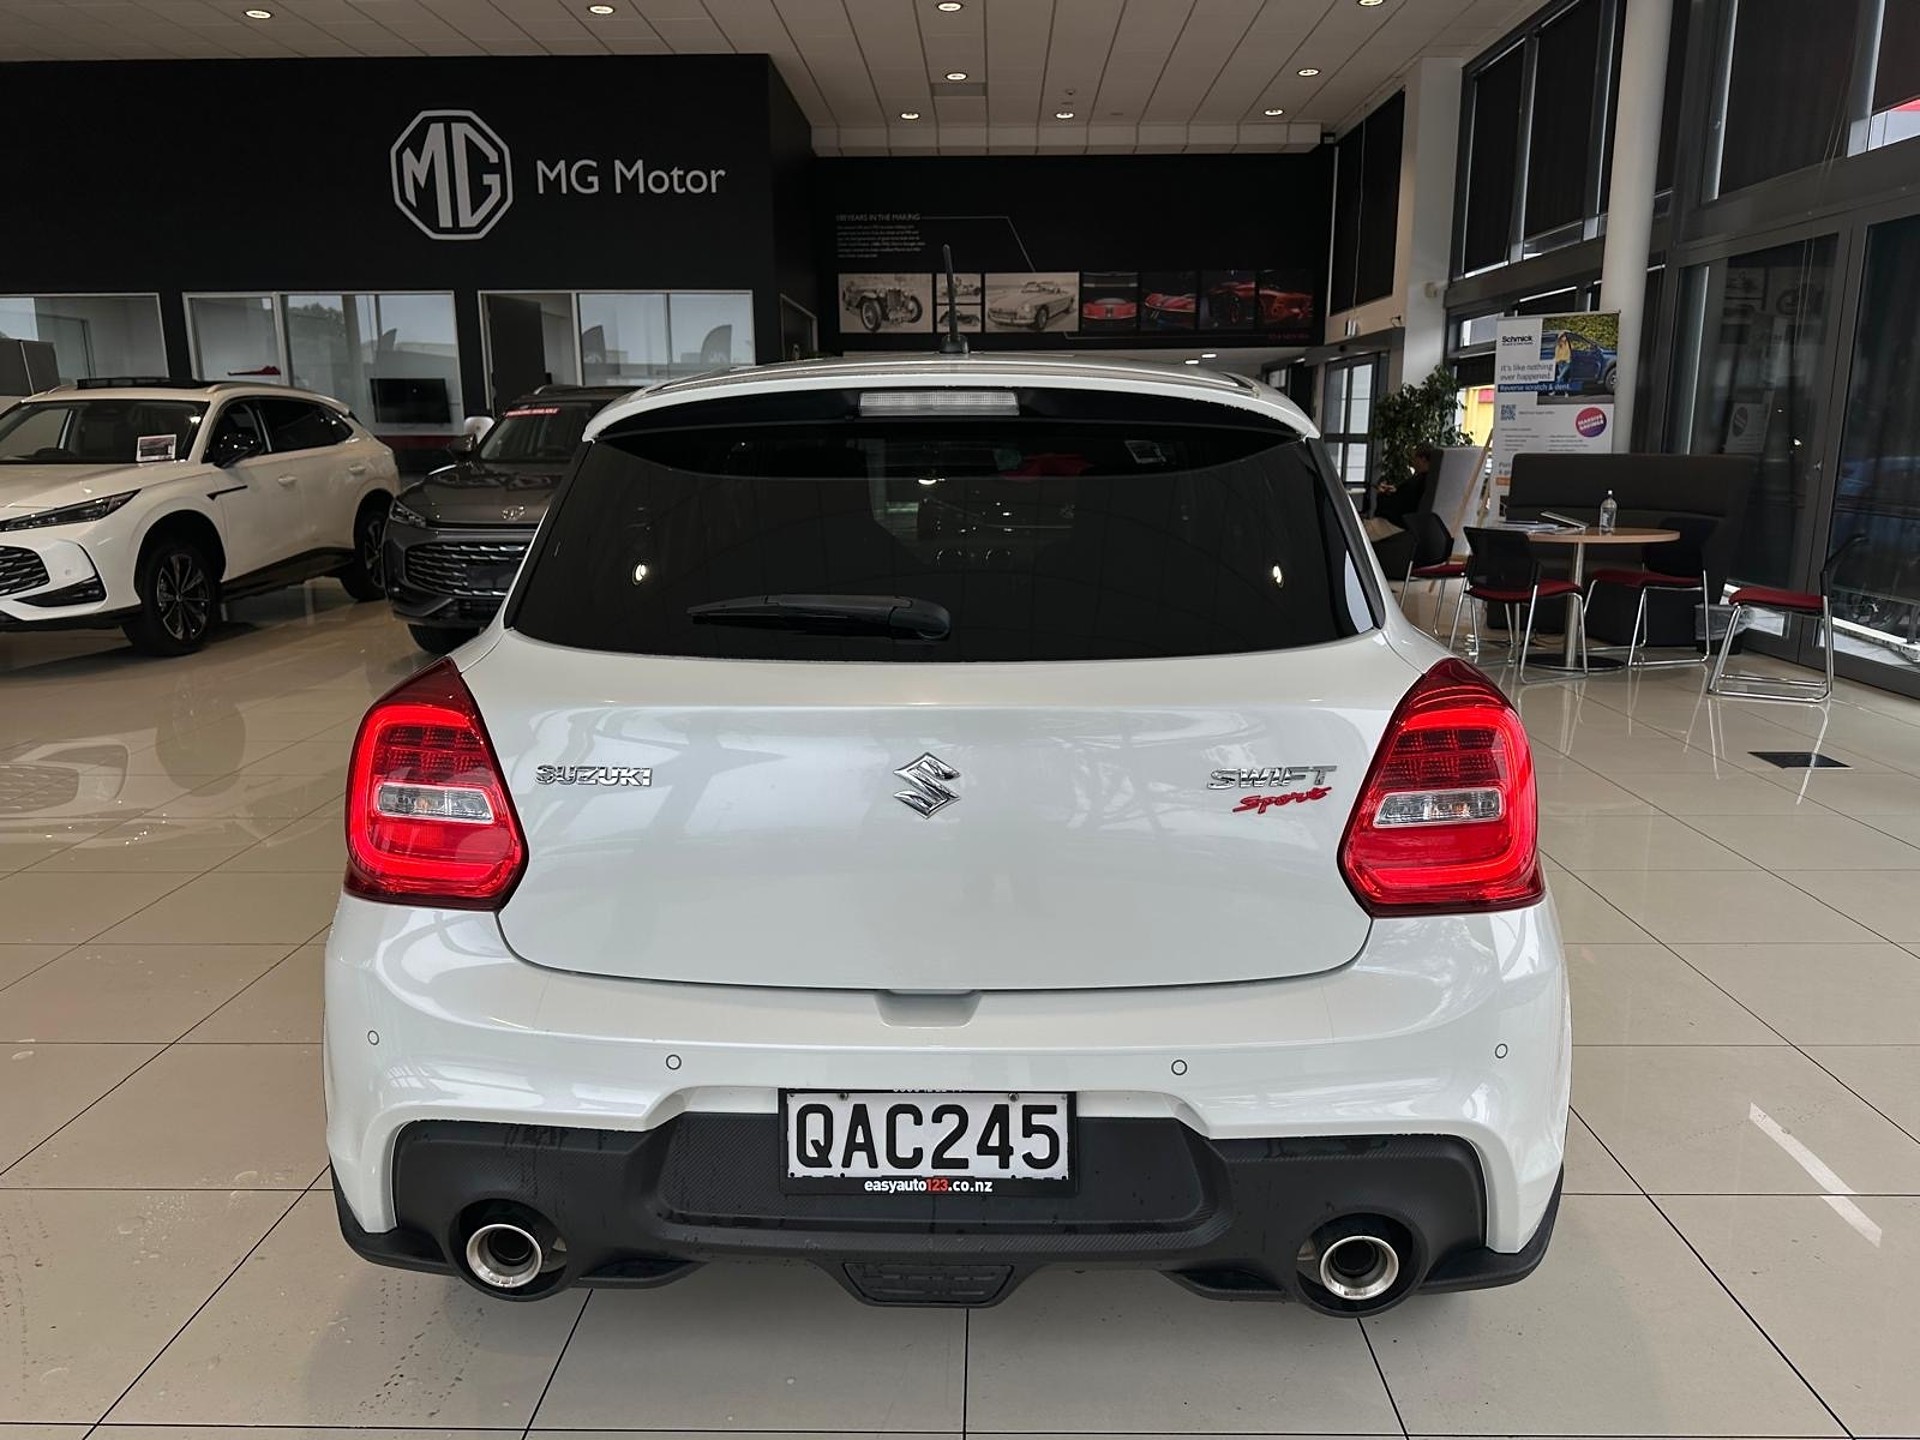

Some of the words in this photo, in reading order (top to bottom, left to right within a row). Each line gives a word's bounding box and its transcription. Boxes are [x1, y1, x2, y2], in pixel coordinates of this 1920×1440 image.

[401, 122, 502, 228] MG
[536, 159, 599, 194] MG
[615, 159, 726, 194] Motor
[1501, 335, 1533, 343] Schmick
[1500, 364, 1512, 372] It's
[1526, 363, 1553, 372] nothing
[535, 764, 653, 787] SUZUKI
[1207, 765, 1337, 790] SWIFT
[1232, 786, 1332, 814] Sport
[796, 1103, 1060, 1170] QAC245
[863, 1177, 993, 1194] easyauto123.co.nz
